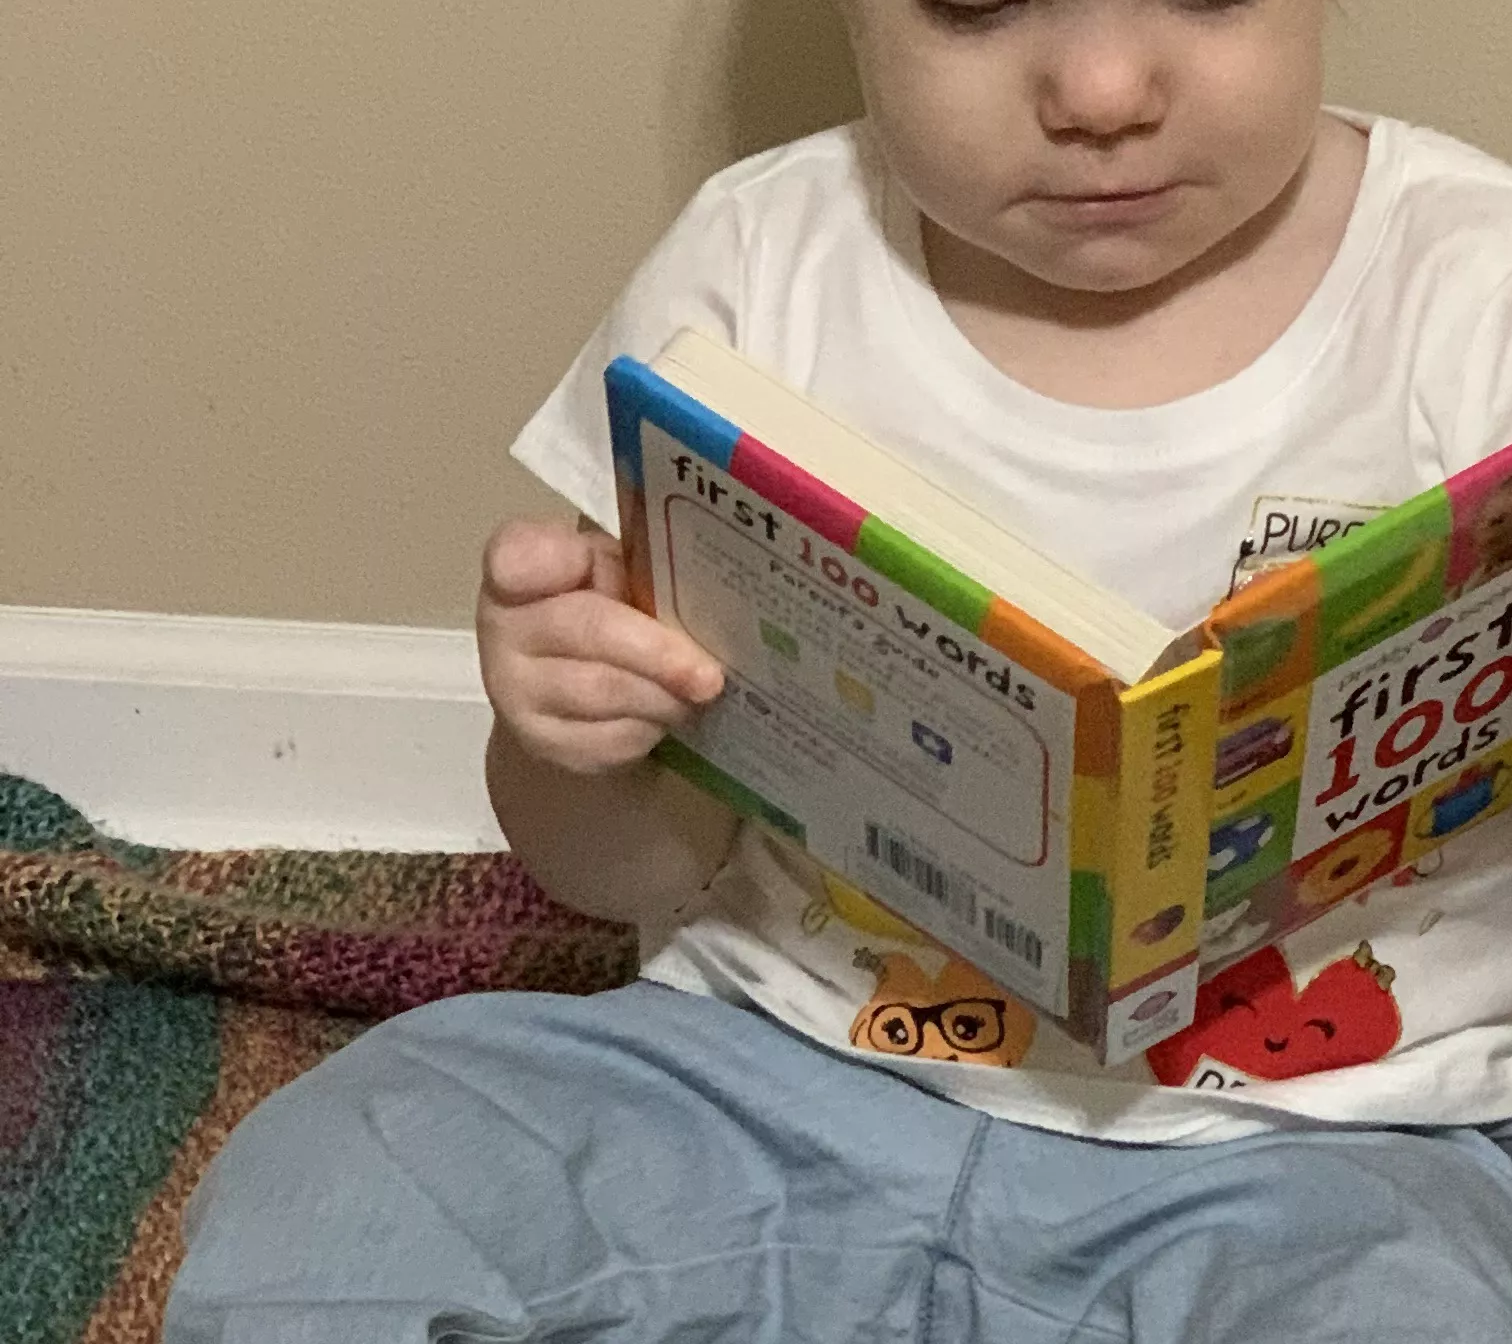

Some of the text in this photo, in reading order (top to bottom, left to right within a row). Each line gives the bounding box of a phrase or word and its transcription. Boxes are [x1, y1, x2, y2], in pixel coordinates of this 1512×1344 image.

[671, 455, 783, 542] first
[797, 537, 881, 608] 100
[894, 604, 1037, 712] words
[1259, 511, 1366, 556] PUR
[1324, 716, 1502, 833] words
